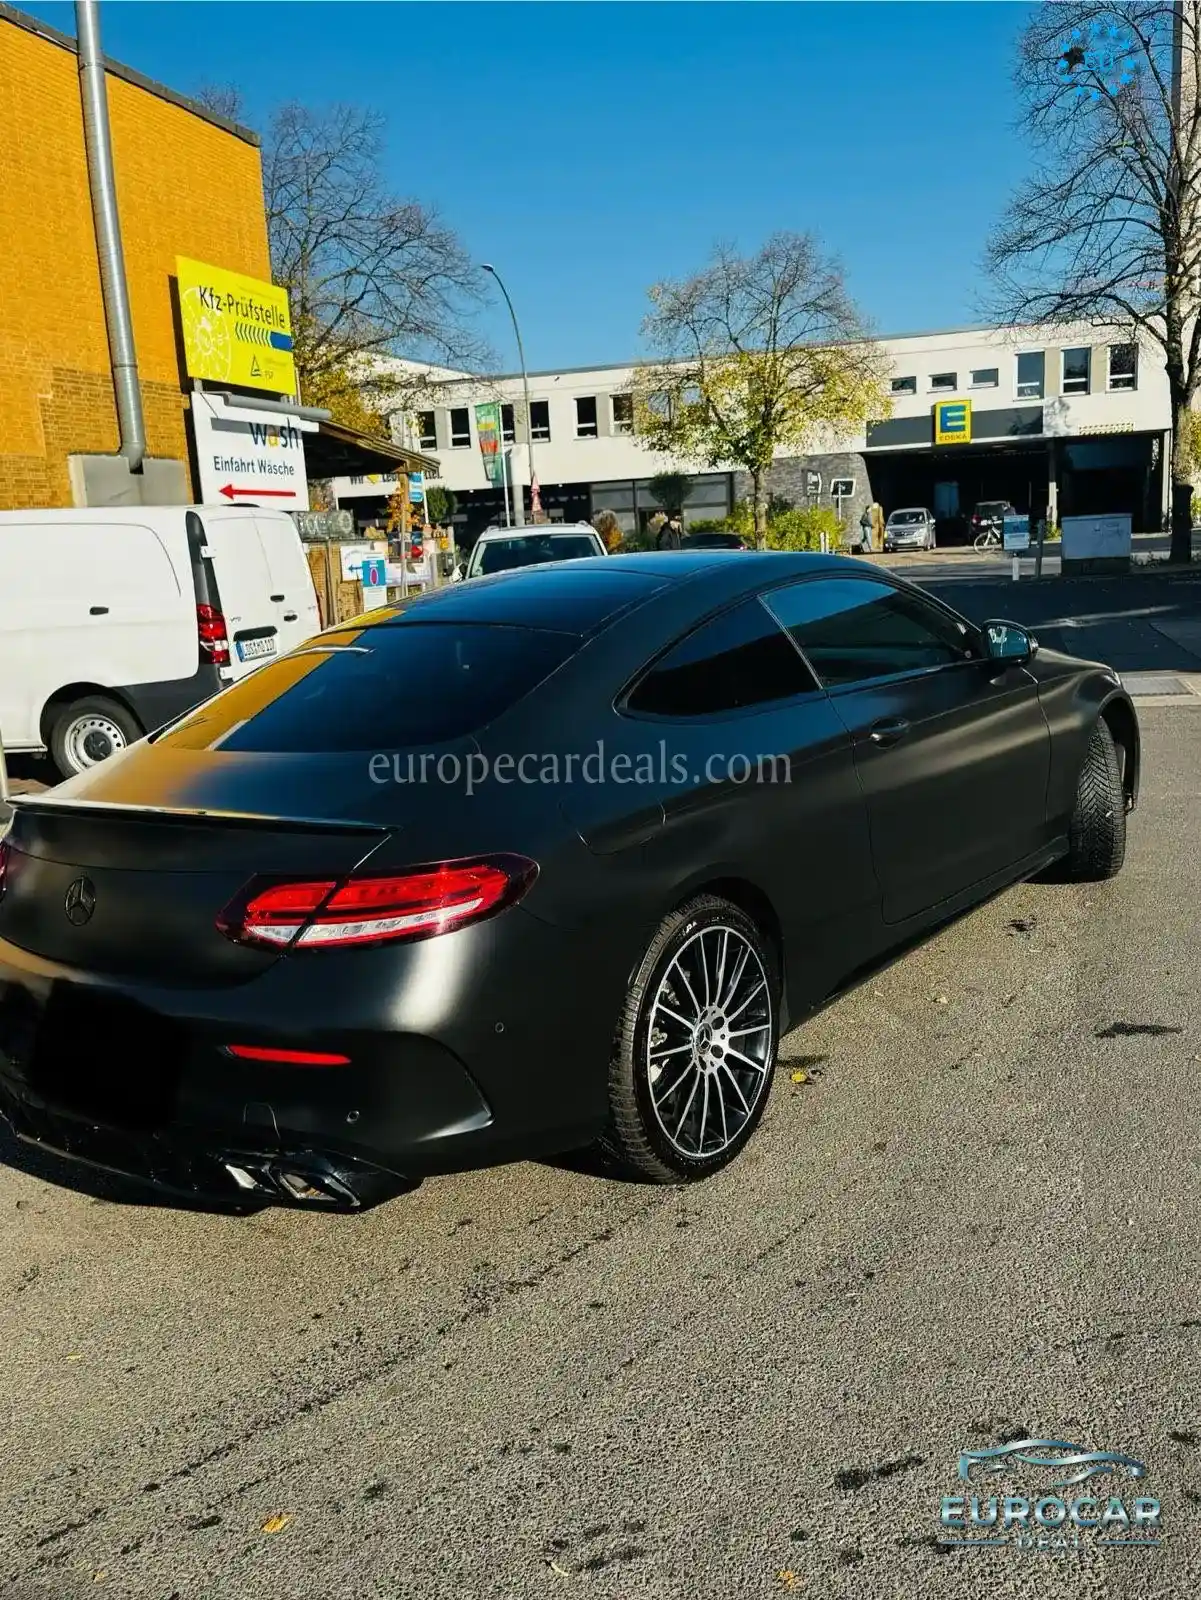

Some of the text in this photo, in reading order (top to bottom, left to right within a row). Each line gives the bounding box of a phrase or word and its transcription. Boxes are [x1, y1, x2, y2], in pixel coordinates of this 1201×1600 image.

[198, 285, 285, 328] Kfz-Prüfstelle
[940, 405, 966, 432] E
[213, 455, 295, 475] Einfahrt Wäsche
